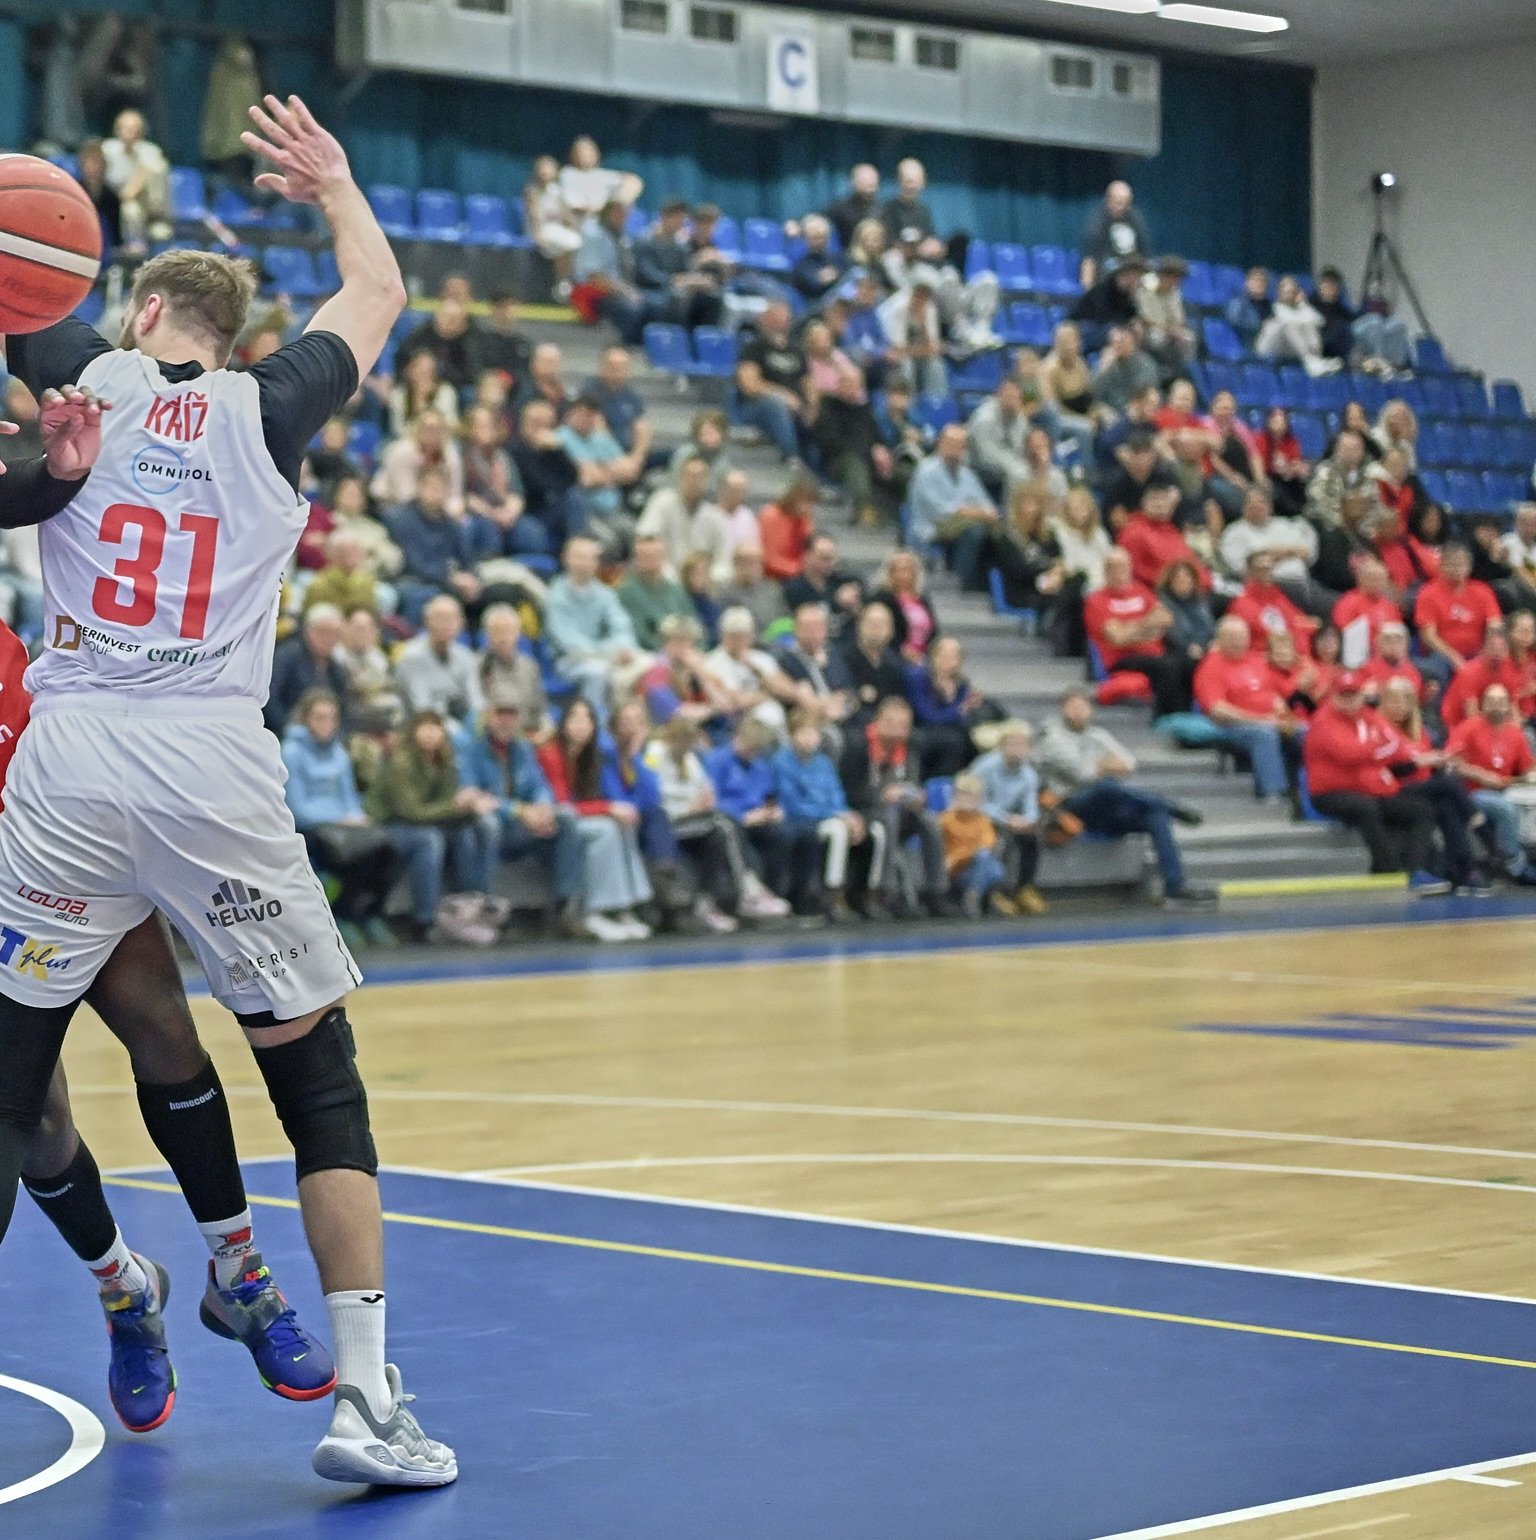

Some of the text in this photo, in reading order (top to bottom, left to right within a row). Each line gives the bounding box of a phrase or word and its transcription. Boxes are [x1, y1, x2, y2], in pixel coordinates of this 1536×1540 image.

[777, 42, 807, 89] C
[138, 461, 213, 482] OMNIPOL
[91, 502, 220, 641] 31
[205, 899, 283, 928] HELIVO
[19, 947, 72, 971] plus
[168, 1086, 219, 1111] homecourt
